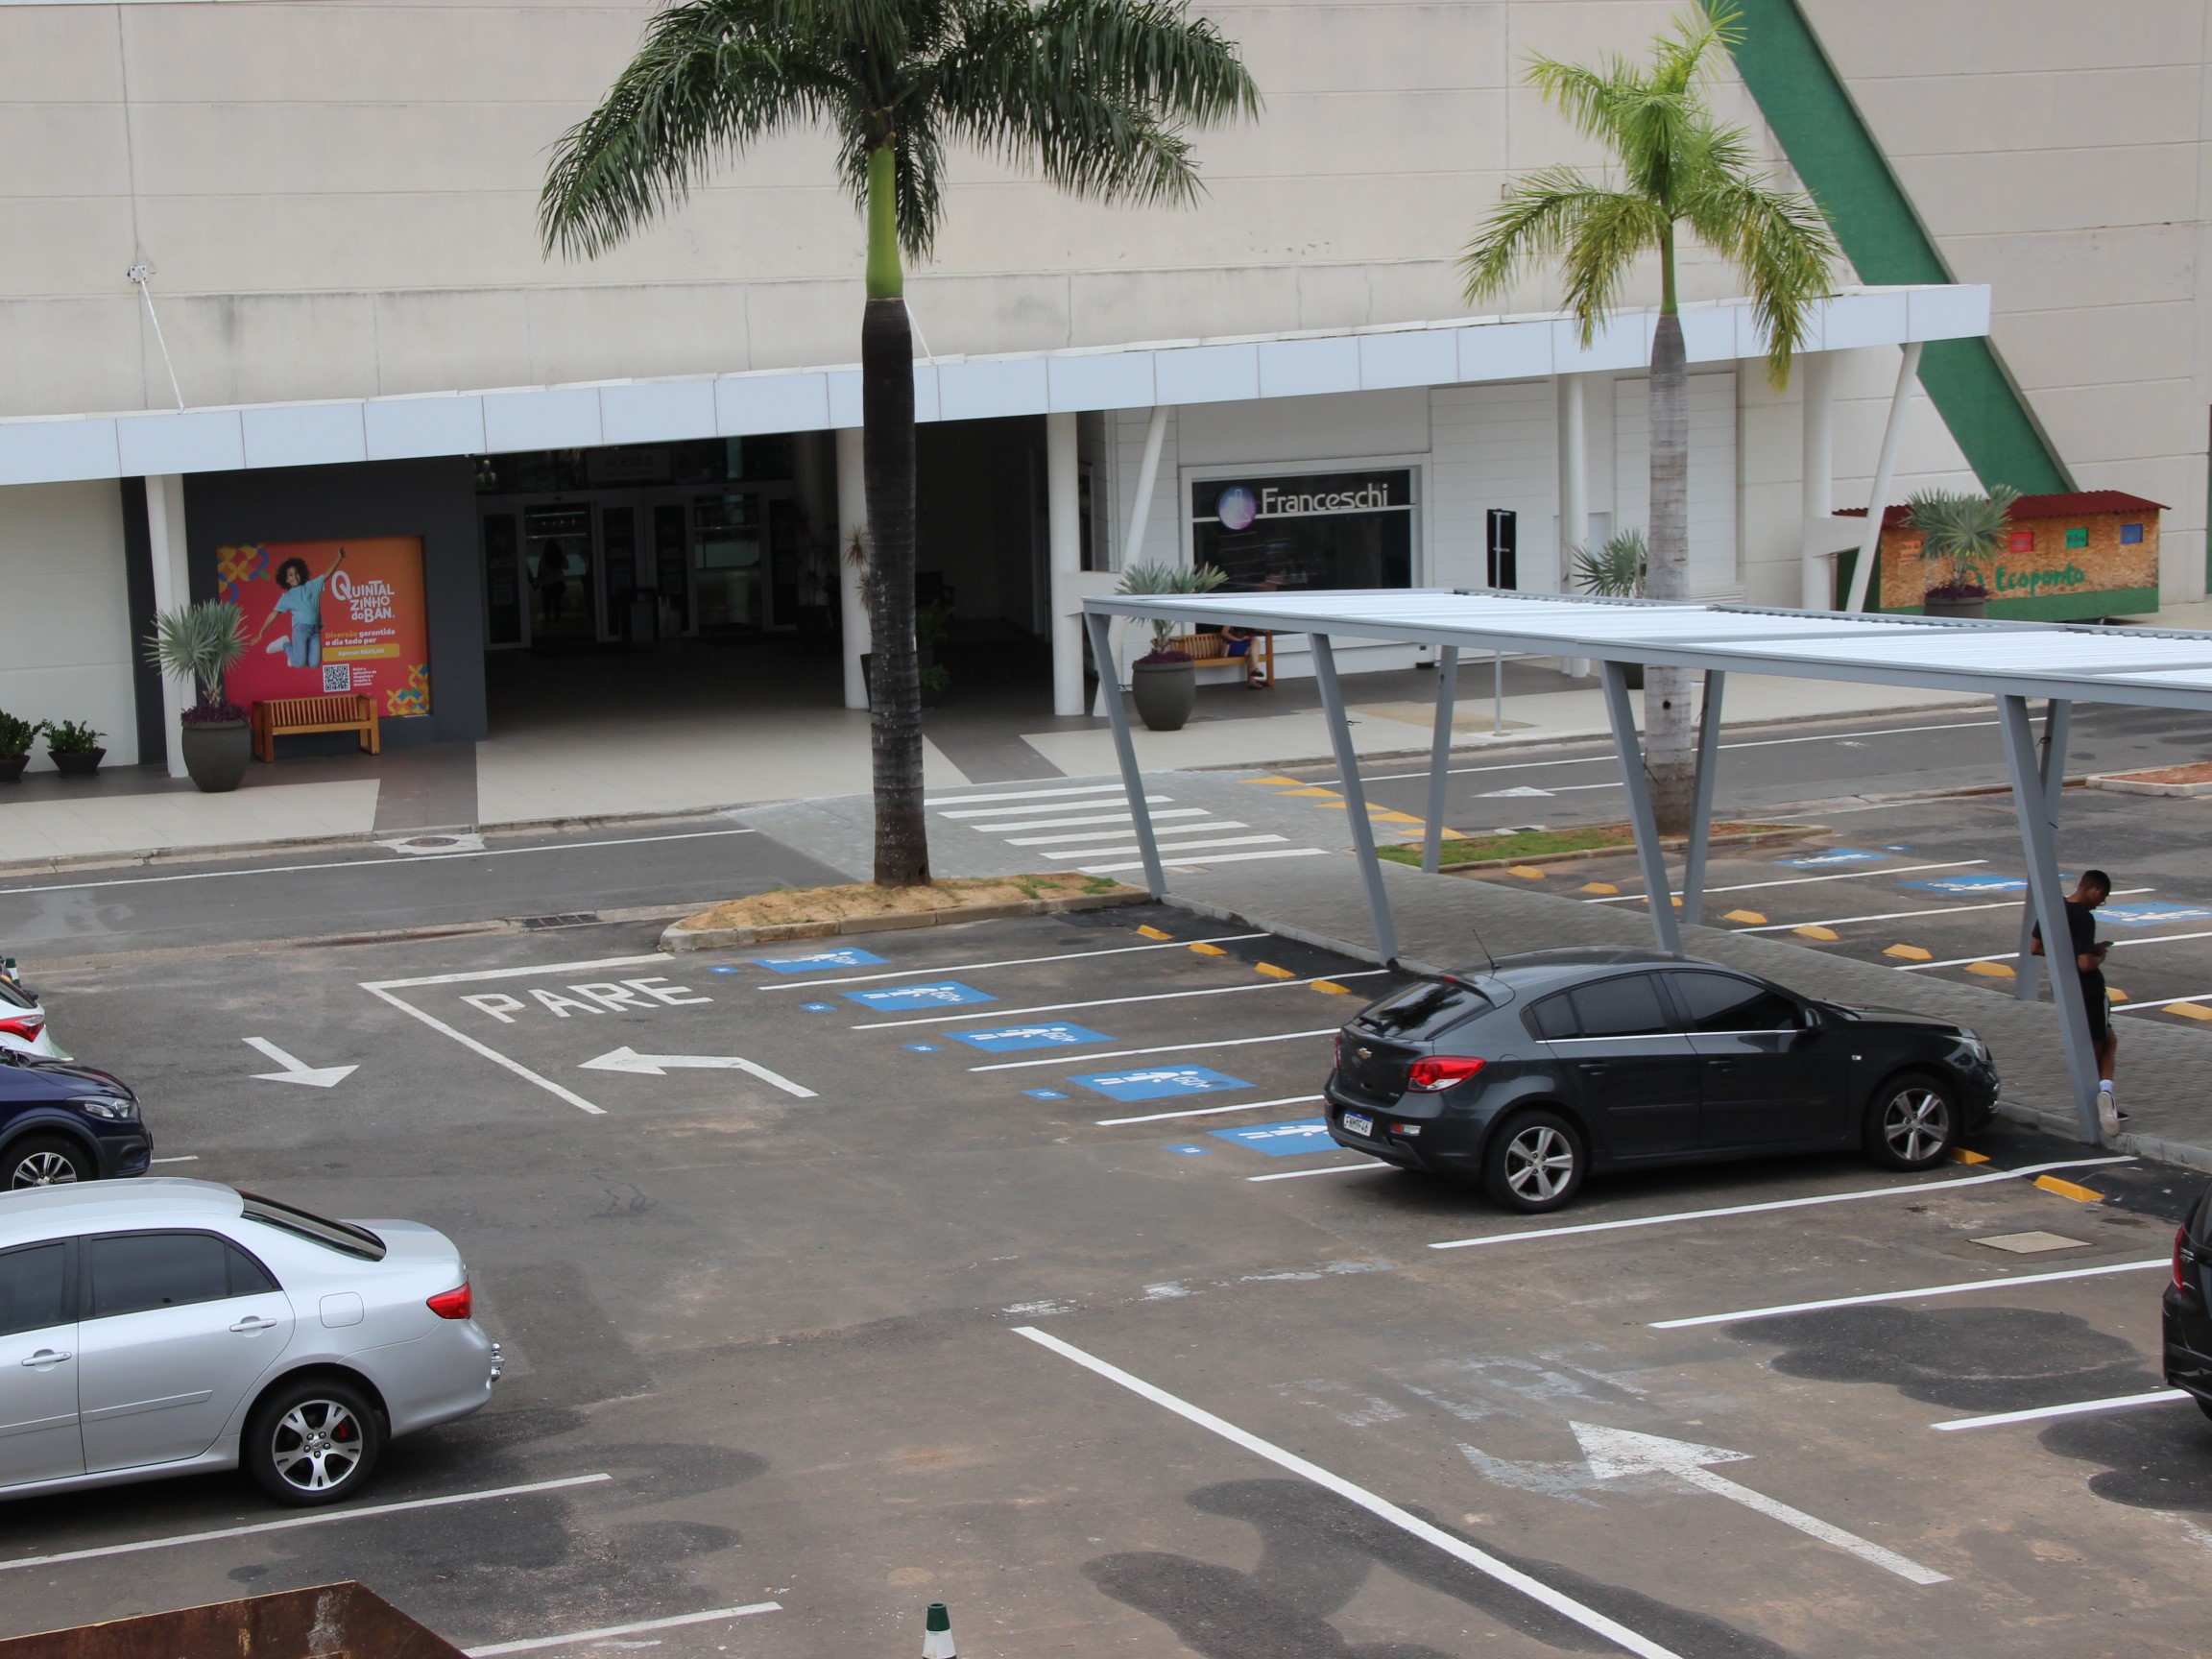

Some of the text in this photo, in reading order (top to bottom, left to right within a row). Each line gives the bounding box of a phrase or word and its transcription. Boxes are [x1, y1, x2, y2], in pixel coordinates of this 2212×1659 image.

[1262, 483, 1389, 515] Franceschi
[1995, 561, 2086, 595] Ecoponto
[349, 595, 391, 612] ZINHO
[325, 628, 396, 638] Diversão garantida
[460, 976, 714, 1023] PARE
[929, 991, 964, 1002] 60+
[1041, 1031, 1079, 1043] 60+
[1171, 1076, 1213, 1089] 60+
